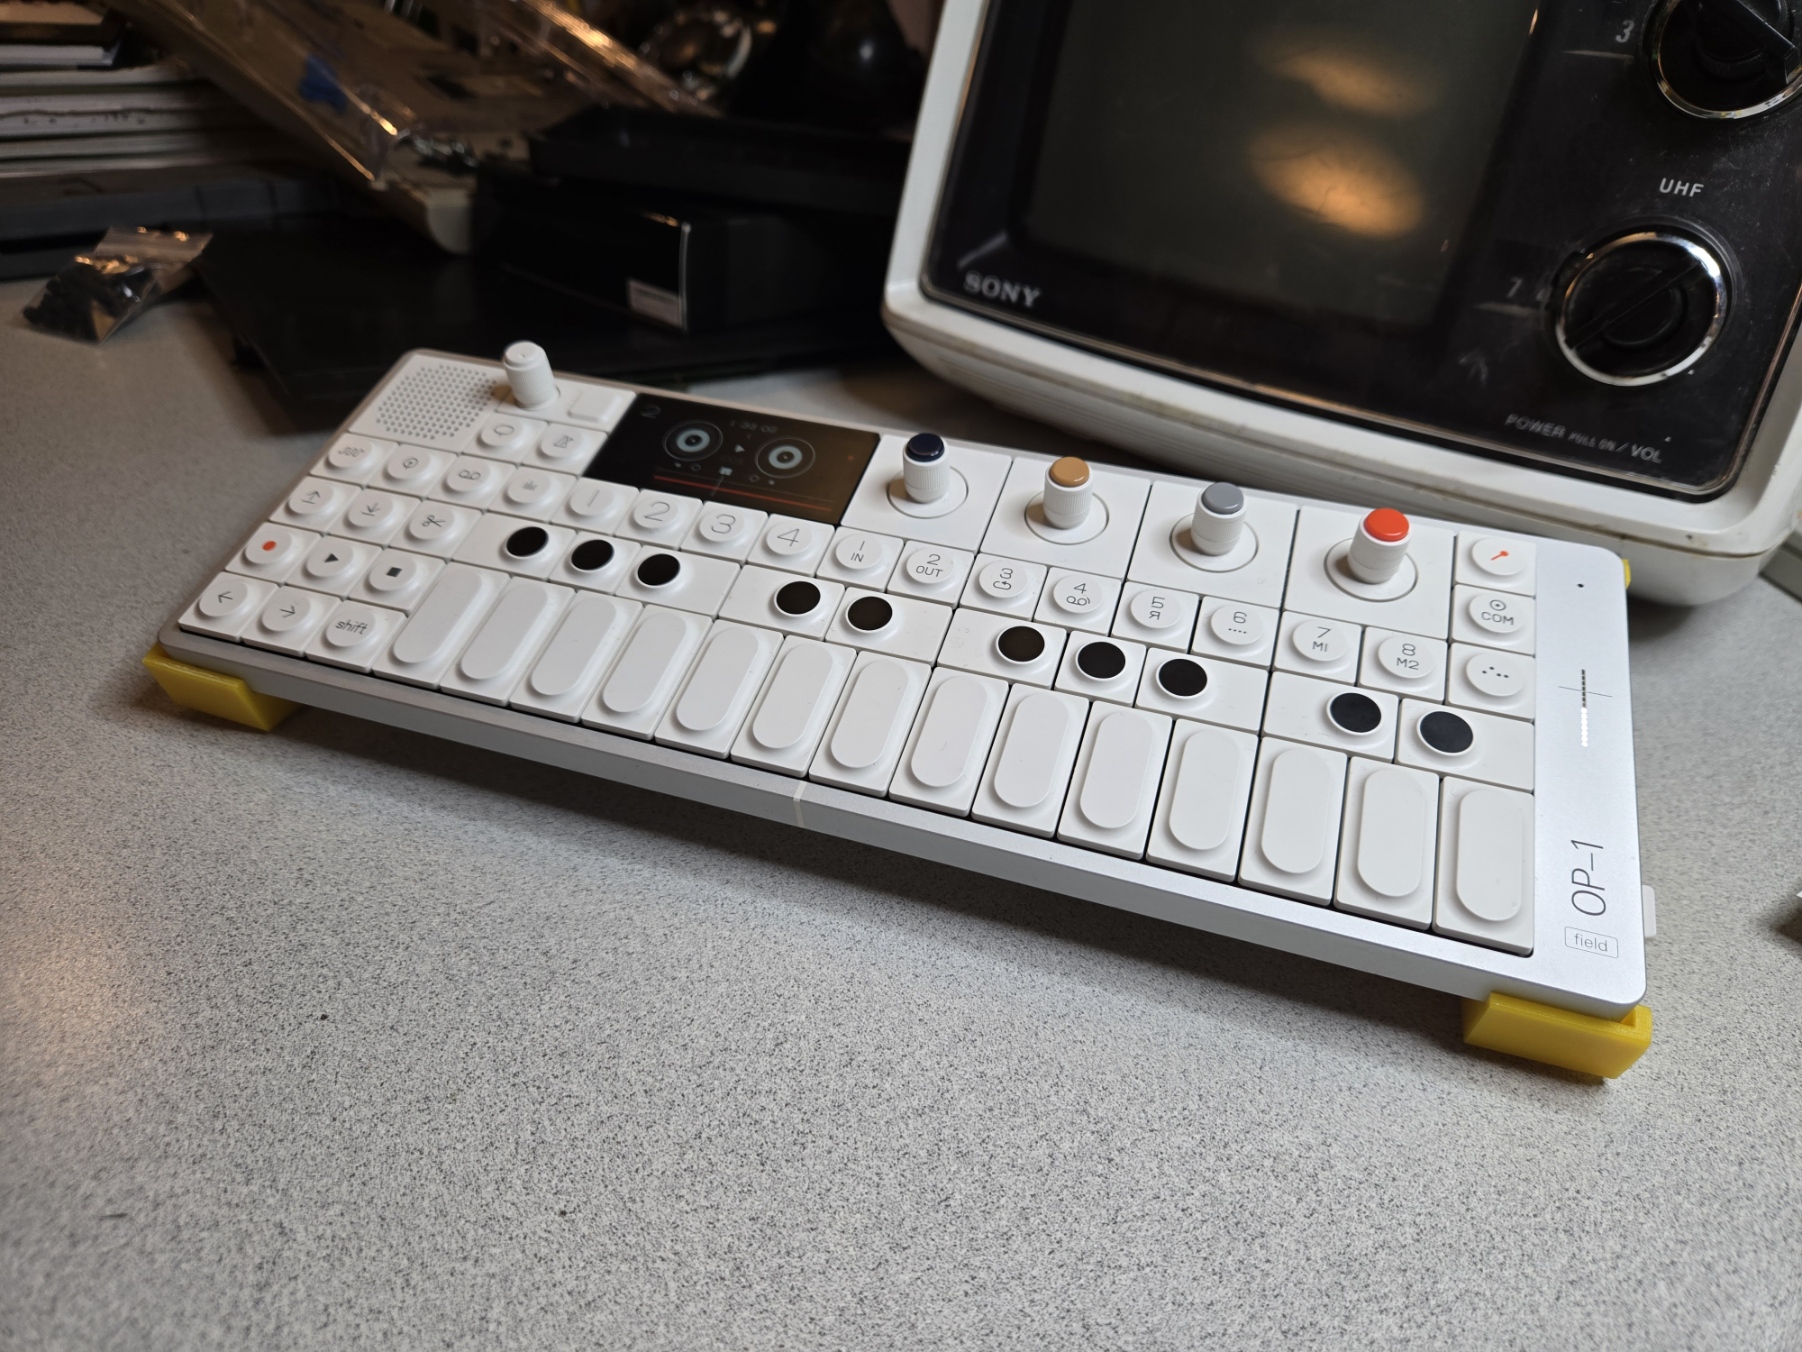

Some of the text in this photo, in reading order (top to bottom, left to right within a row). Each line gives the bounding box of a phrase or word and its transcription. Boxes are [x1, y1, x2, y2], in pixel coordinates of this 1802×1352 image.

[1615, 19, 1635, 44] 3
[1659, 177, 1705, 198] UHF
[963, 270, 1042, 308] SONY
[1504, 413, 1567, 439] POWER
[1567, 431, 1597, 449] PULL
[1630, 443, 1663, 465] VOL
[643, 500, 671, 521] 2
[710, 513, 737, 535] 3
[776, 527, 801, 548] 4
[850, 551, 865, 563] IN
[926, 553, 941, 567] 2
[915, 565, 944, 578] OUT
[999, 567, 1014, 580] 3
[1073, 582, 1088, 595] 4
[1150, 595, 1166, 610] 5
[1232, 610, 1248, 624] 6
[1480, 611, 1515, 626] COM
[335, 619, 369, 635] shift
[1316, 626, 1332, 639] 7
[1401, 643, 1417, 656] 8
[1396, 657, 1420, 670] M2
[1570, 839, 1607, 917] OP-1
[1573, 933, 1609, 952] field
